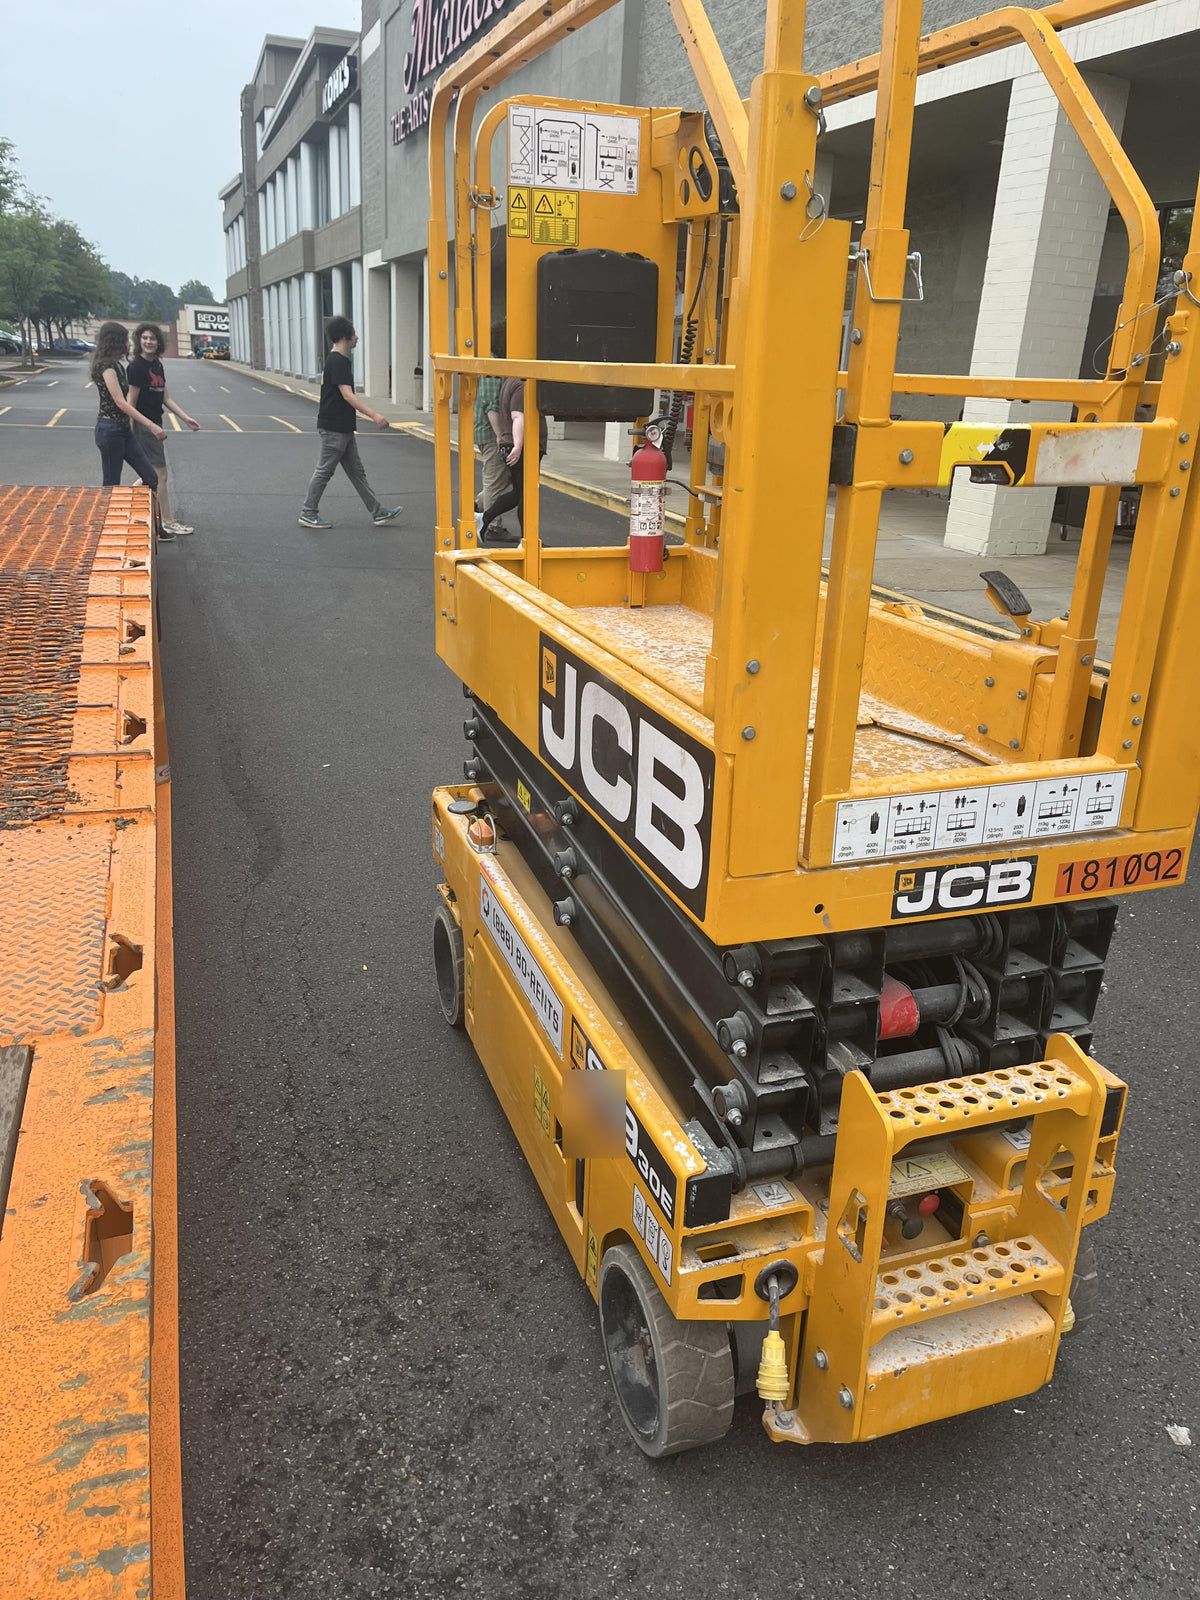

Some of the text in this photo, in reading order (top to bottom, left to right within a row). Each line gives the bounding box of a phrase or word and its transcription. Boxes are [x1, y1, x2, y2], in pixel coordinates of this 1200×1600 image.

[403, 0, 504, 94] Michae
[322, 55, 350, 114] KOHL'S
[391, 87, 429, 144] THE ARTS
[197, 313, 216, 322] BED
[542, 662, 705, 890] JCB
[896, 861, 1033, 914] JCB
[1062, 848, 1183, 894] 181092
[492, 907, 559, 1034] (888) 80-RENTS
